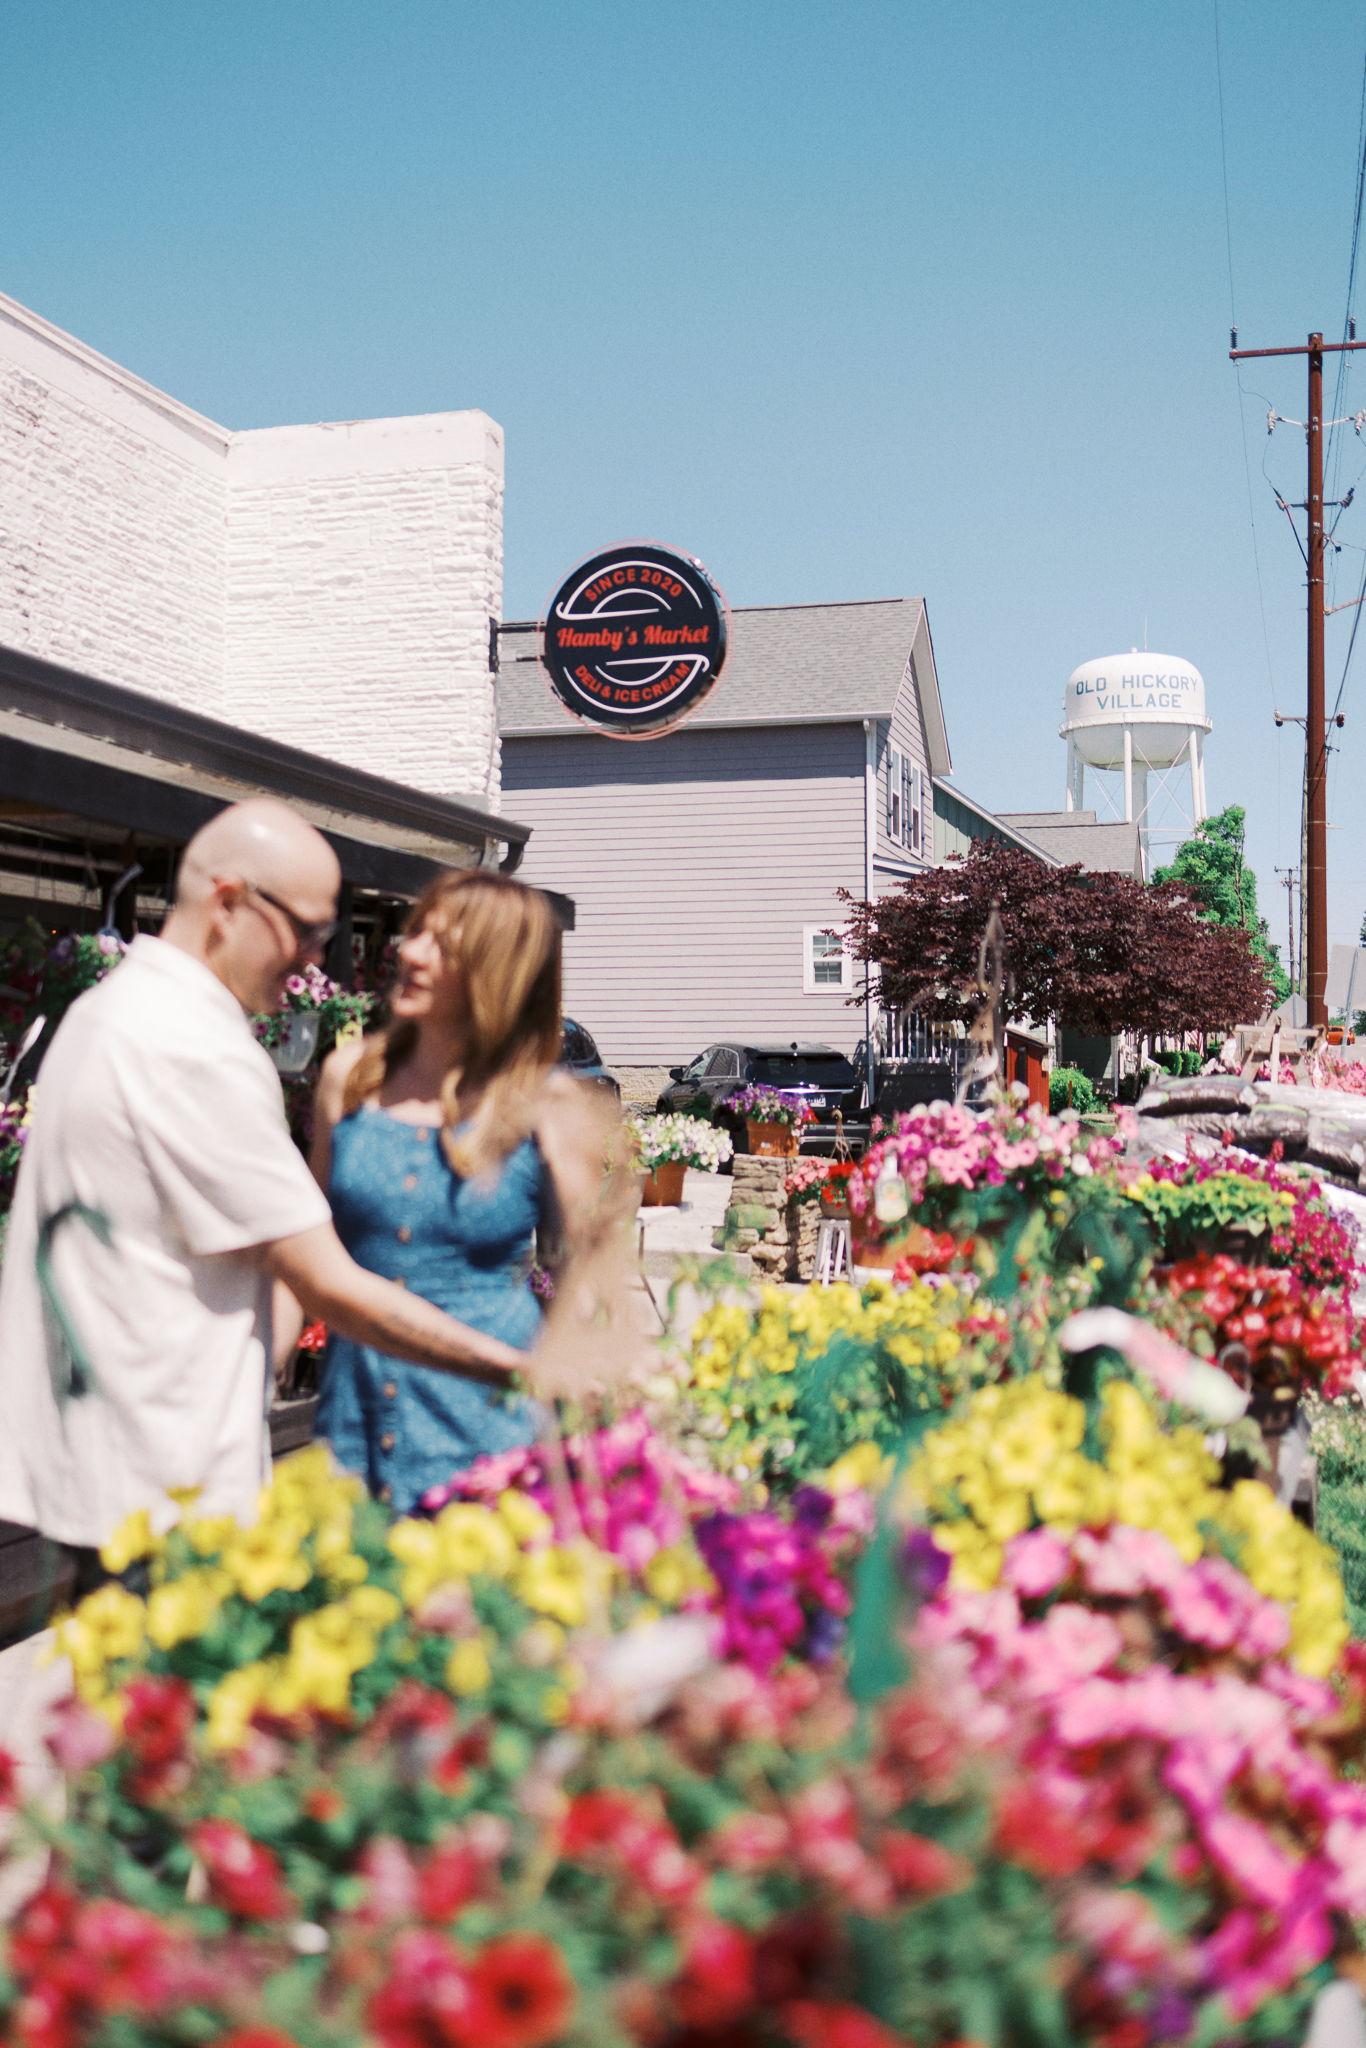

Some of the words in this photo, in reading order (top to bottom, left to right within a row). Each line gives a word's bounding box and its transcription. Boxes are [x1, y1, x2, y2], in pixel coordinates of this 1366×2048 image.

[585, 568, 636, 601] SINCE
[641, 568, 683, 597] 2020
[557, 627, 638, 651] Hamby's
[643, 624, 710, 645] Market
[574, 664, 602, 692] DELI
[602, 686, 611, 699] &
[643, 662, 690, 700] CREAM
[1076, 677, 1107, 695] OLD
[1122, 674, 1198, 691] HICKORY
[1097, 693, 1182, 710] VILLAGE
